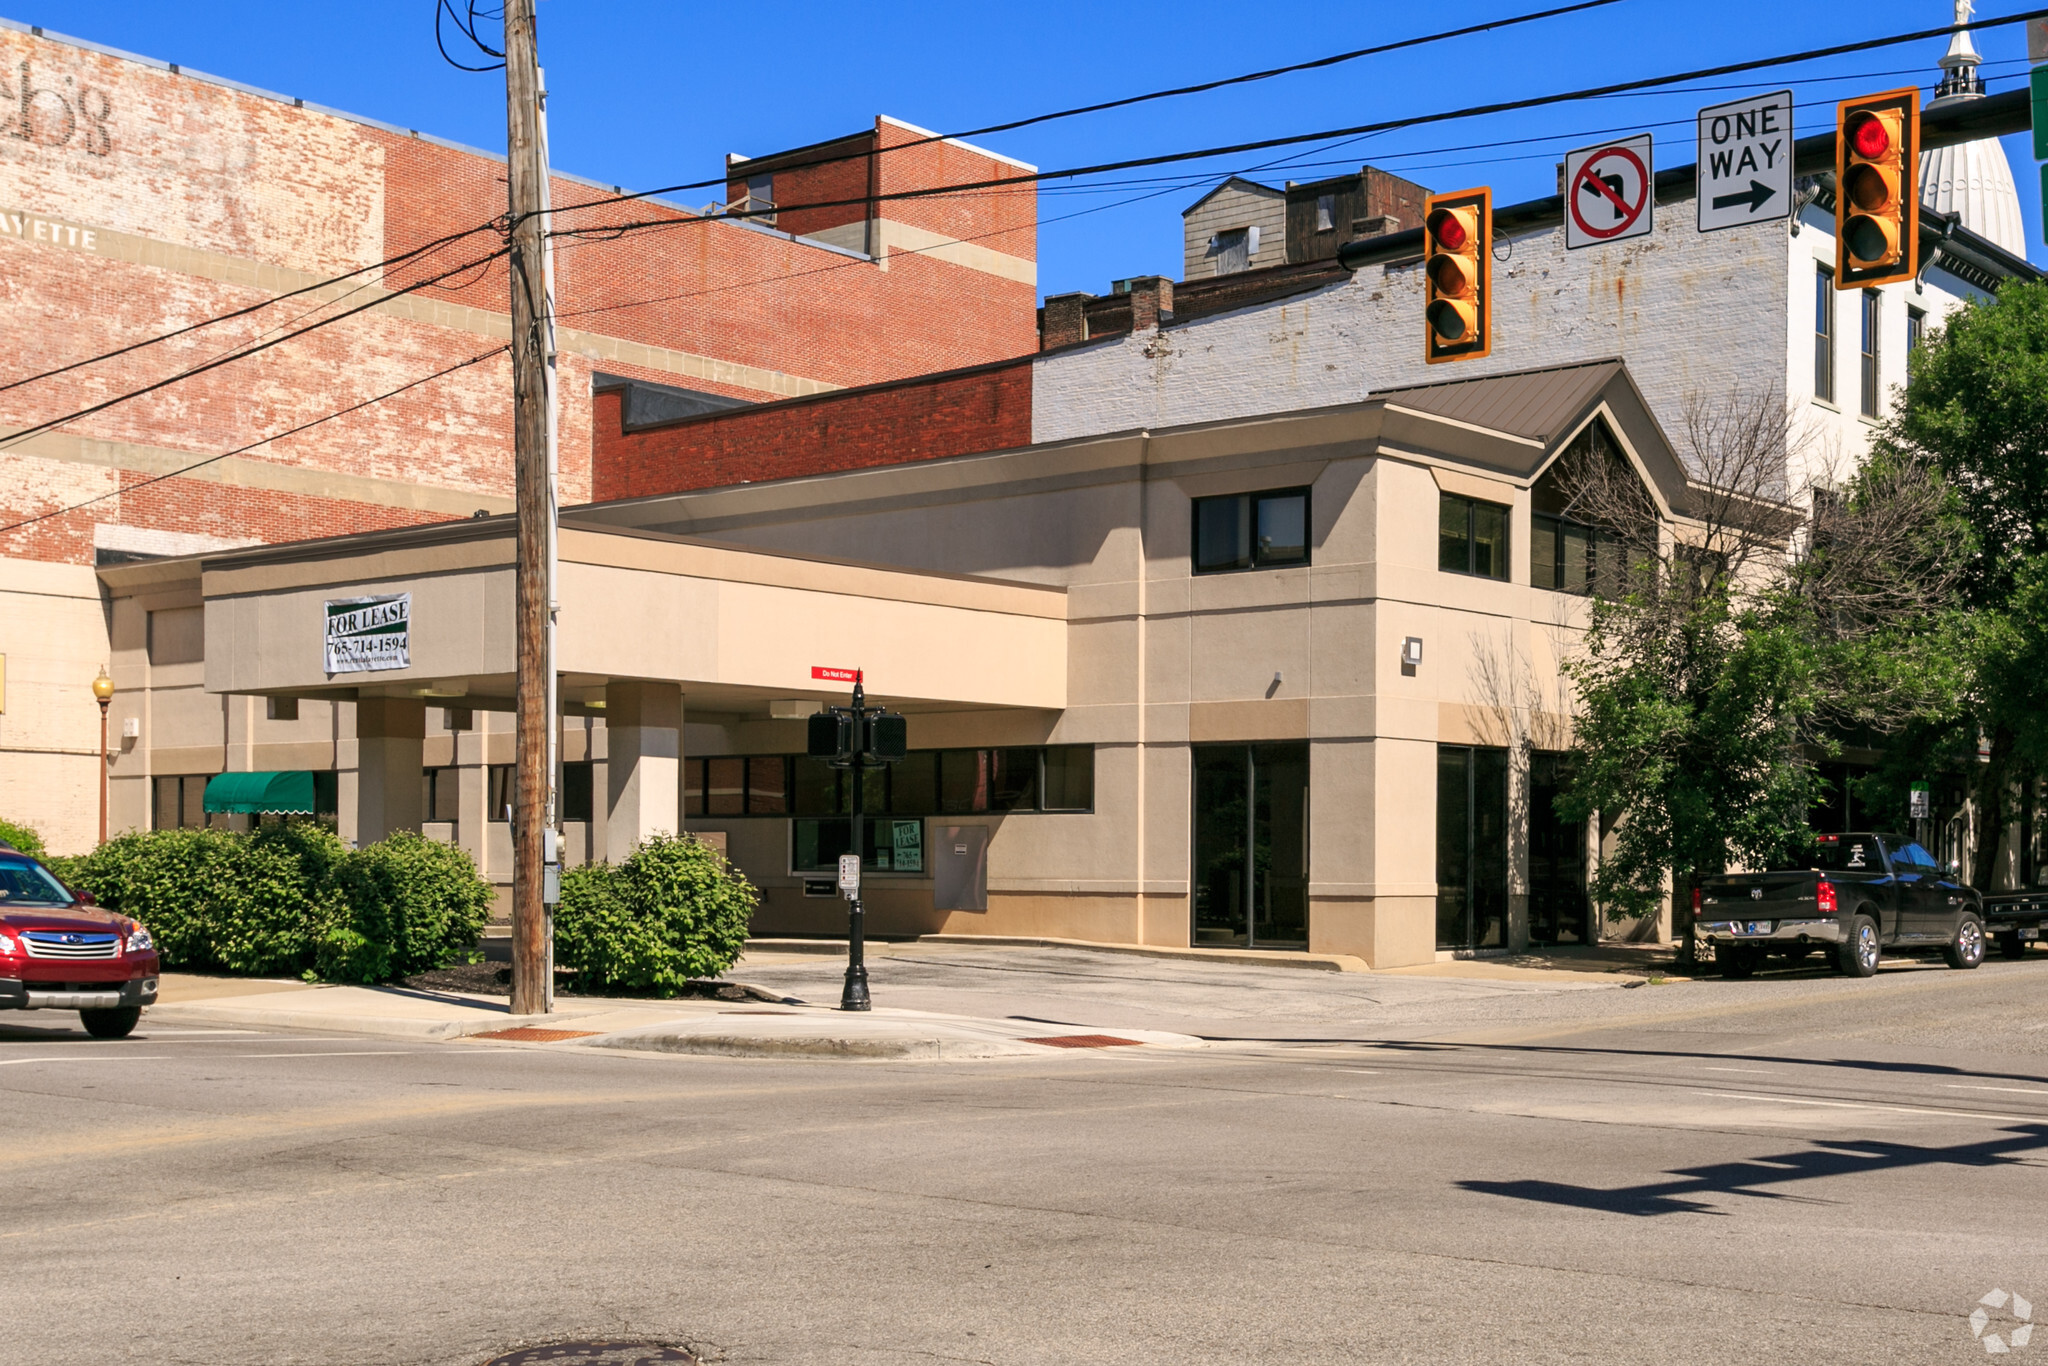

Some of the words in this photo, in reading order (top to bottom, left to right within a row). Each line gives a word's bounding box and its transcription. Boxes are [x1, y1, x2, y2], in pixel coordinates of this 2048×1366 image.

[1711, 104, 1779, 145] ONE
[1710, 139, 1782, 180] WAY
[328, 613, 357, 635] FOR
[362, 601, 408, 629] LEASE
[328, 637, 407, 656] 765-714-1594
[896, 834, 918, 847] LEASE
[899, 825, 914, 836] FOR
